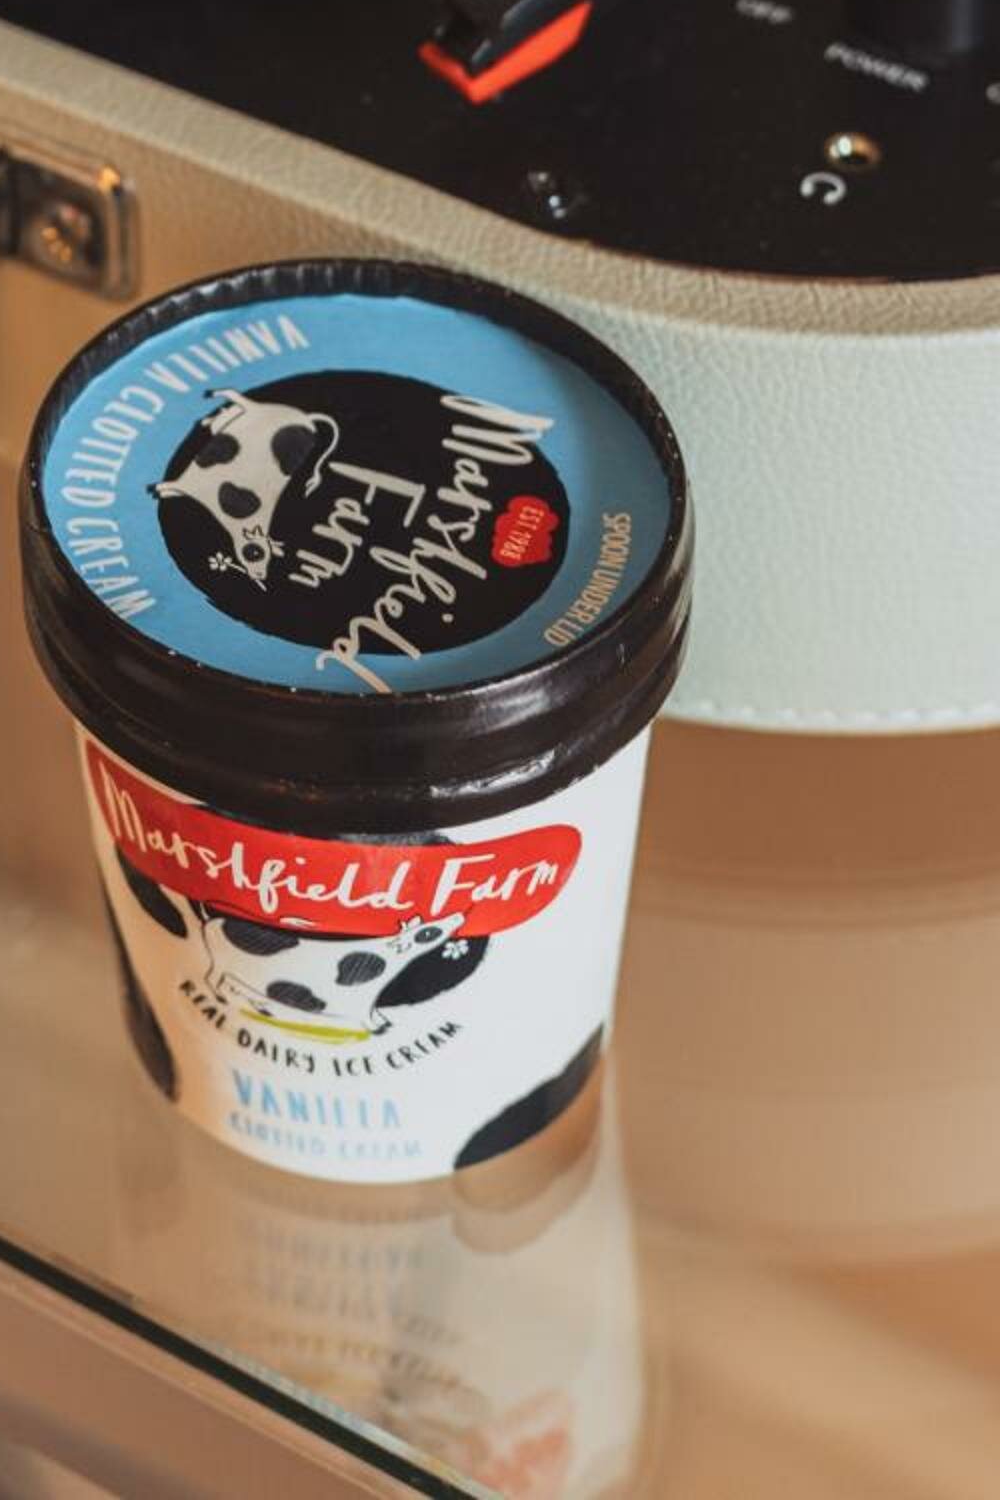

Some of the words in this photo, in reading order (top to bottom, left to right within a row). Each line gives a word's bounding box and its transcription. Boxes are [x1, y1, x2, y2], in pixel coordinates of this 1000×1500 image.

[824, 42, 928, 92] POWER
[144, 314, 310, 393] VANILLA
[60, 385, 165, 508] CLOTTED
[66, 516, 157, 619] CREAM
[289, 461, 426, 588] Farm
[316, 395, 554, 692] Marshfield
[598, 512, 632, 570] SPOON
[544, 617, 586, 647] LID
[567, 567, 623, 625] UNDER
[99, 758, 414, 912] Marshfield
[430, 853, 558, 915] Farm
[179, 979, 227, 1029] REAL
[237, 1028, 316, 1073] DAIRY
[332, 1056, 374, 1077] ICE
[386, 1019, 463, 1070] CREAM
[231, 1068, 401, 1129] VANILLA
